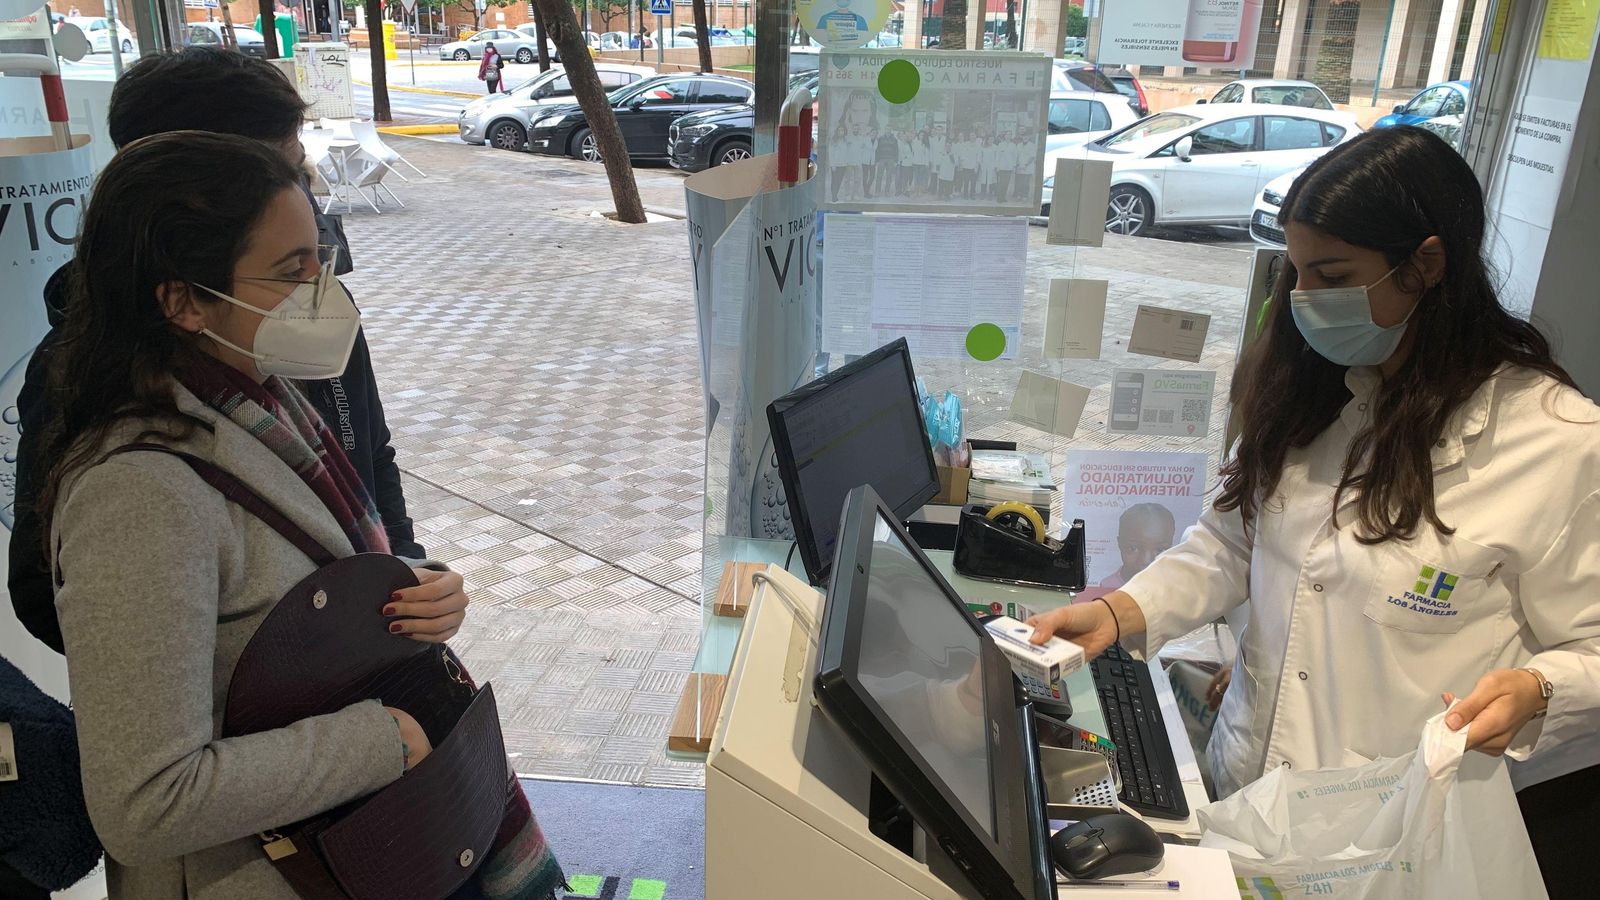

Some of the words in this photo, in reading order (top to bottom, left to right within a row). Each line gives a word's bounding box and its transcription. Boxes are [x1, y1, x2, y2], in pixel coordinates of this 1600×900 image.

[1387, 596, 1408, 608] LOS
[1403, 591, 1451, 609] FARMACIA
[1296, 871, 1340, 884] FARMACIA
[1340, 866, 1358, 877] LOS
[1304, 881, 1333, 895] 24H
